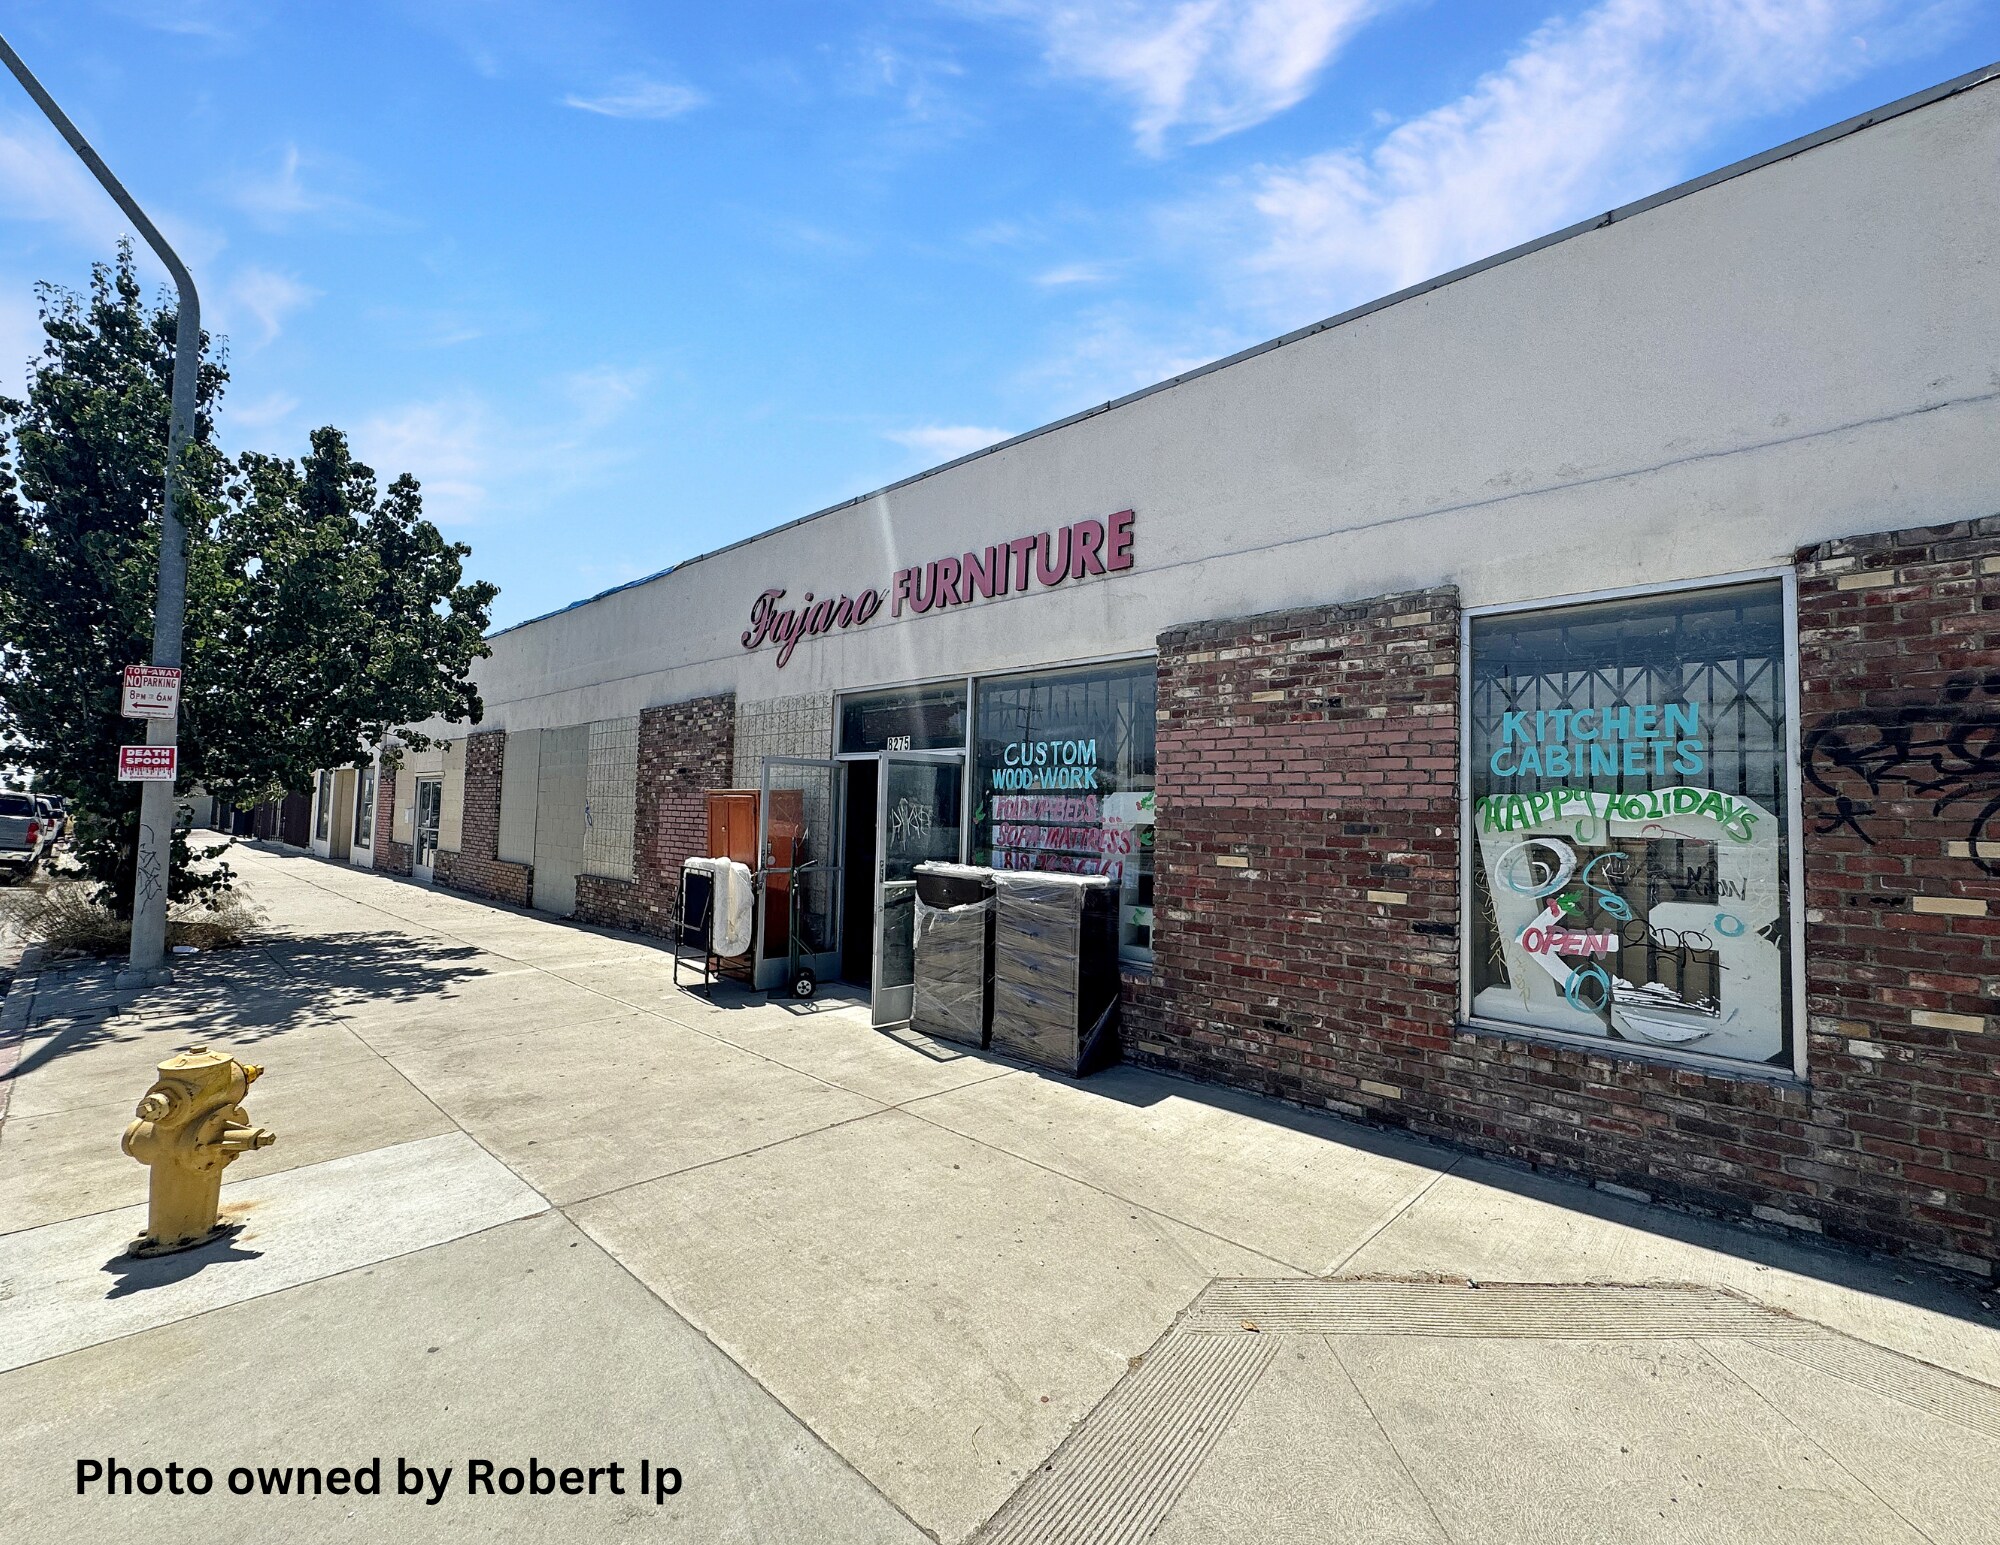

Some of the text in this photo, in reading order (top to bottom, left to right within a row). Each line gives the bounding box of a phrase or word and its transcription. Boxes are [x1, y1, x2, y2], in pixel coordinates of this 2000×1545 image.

[741, 509, 1135, 669] Fajaro FURNITURE
[126, 675, 177, 689] NO PARKING
[128, 667, 179, 677] TOW-AWAY
[130, 690, 147, 700] 8PM
[156, 691, 173, 702] 6AM
[1502, 702, 1699, 744] KITCHEN
[126, 749, 170, 757] DEATH
[888, 736, 909, 751] 8275
[1004, 739, 1097, 766] CUSTOM
[125, 757, 170, 765] SPOON
[1490, 739, 1704, 778] CABINETS
[1603, 786, 1760, 844] HOLIDAYS
[1522, 925, 1612, 960] OPEN
